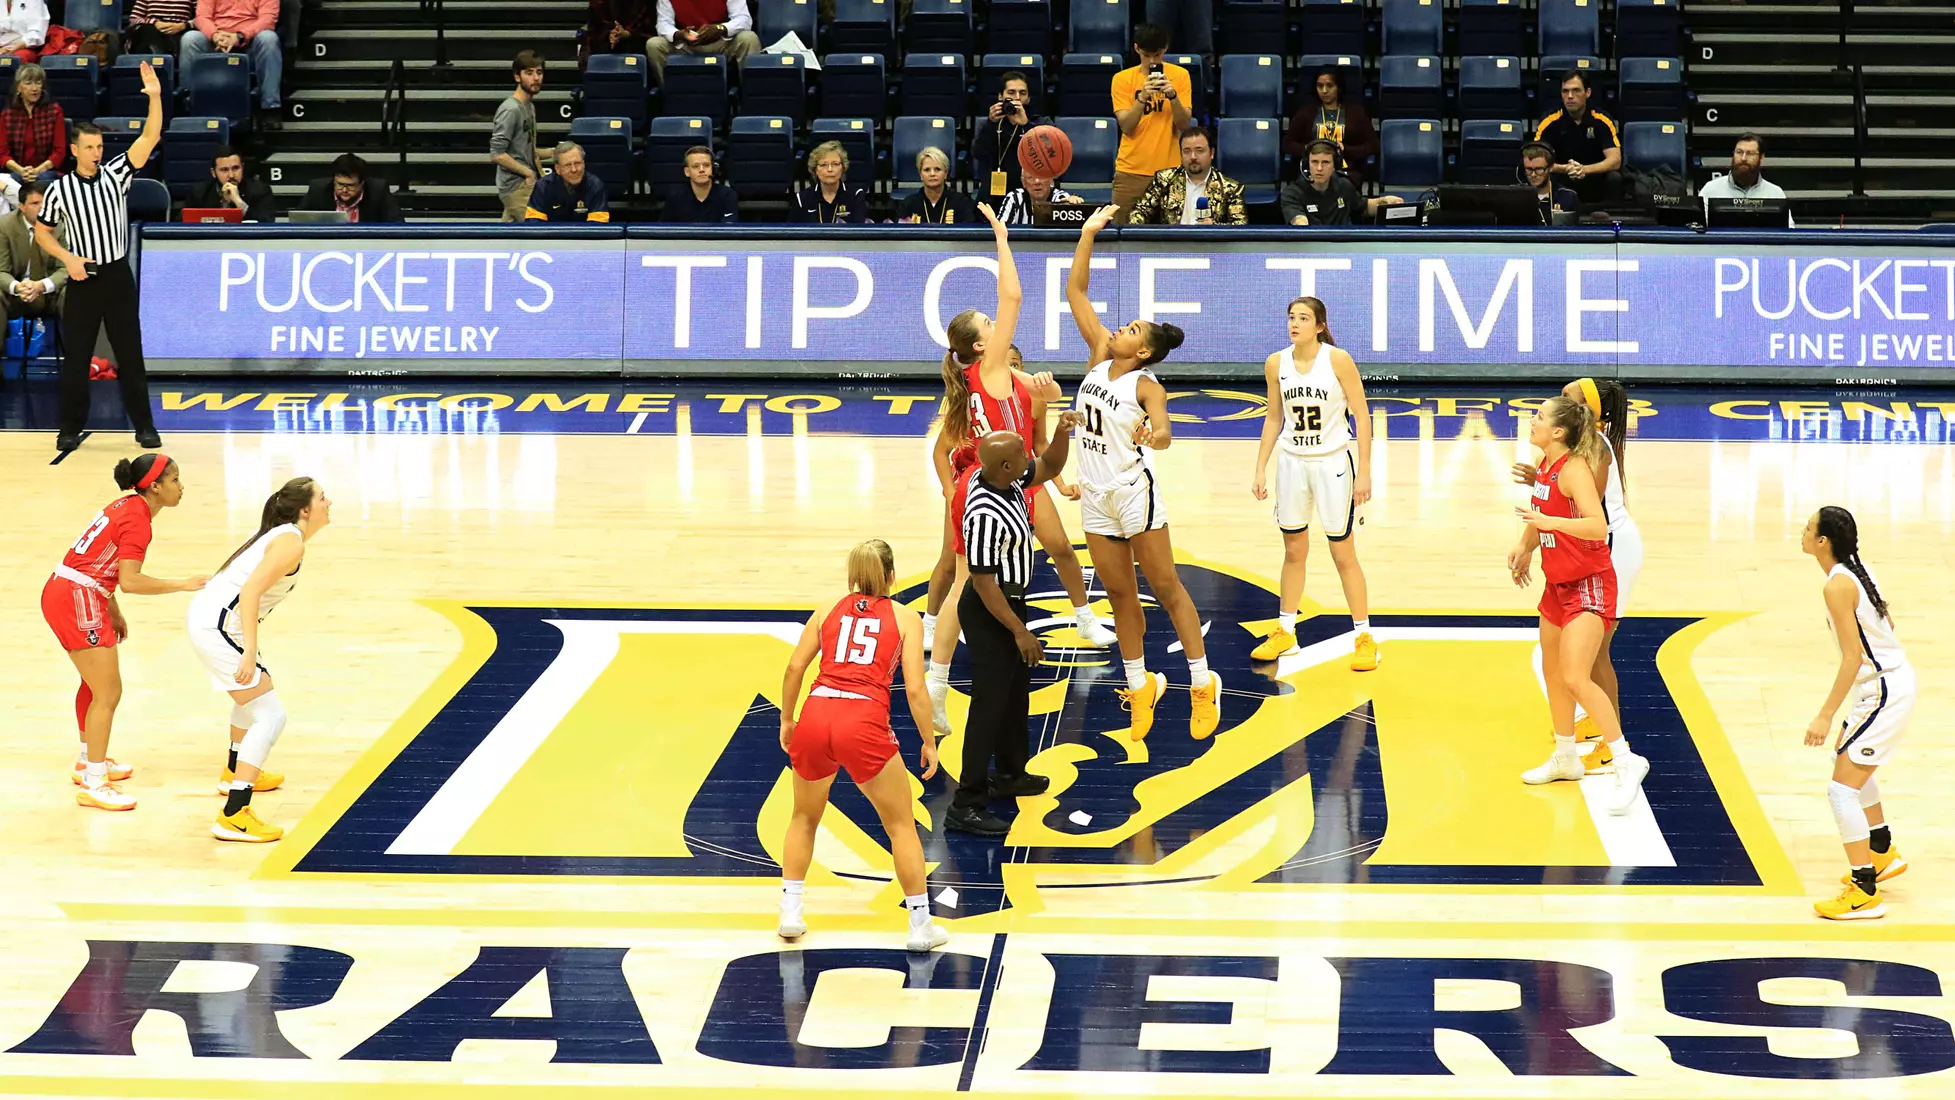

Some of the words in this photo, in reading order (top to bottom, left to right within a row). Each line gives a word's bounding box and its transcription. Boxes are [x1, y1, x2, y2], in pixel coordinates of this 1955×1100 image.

[315, 43, 327, 57] D
[1702, 46, 1714, 60] D
[292, 104, 305, 117] C
[560, 104, 572, 118] C
[1706, 108, 1718, 122] C
[270, 167, 282, 181] B
[1053, 210, 1085, 221] POSS.
[219, 251, 554, 313] PUCKETT'S
[1714, 257, 1955, 321] PUCKET
[641, 255, 874, 349] TIP
[923, 256, 1211, 350] OFF
[1265, 257, 1642, 353] TIME
[271, 326, 345, 352] FINE
[355, 326, 500, 358] JEWELRY
[1769, 333, 1845, 360] FINE
[1857, 334, 1955, 367] JEWEL
[161, 392, 676, 412] WELCOME
[705, 394, 841, 414] TO
[1081, 383, 1120, 412] MURRAY
[1283, 386, 1329, 402] MURRAY
[1084, 403, 1104, 438] 11
[1292, 405, 1322, 431] 32
[1082, 437, 1108, 455] STATE
[1292, 434, 1322, 446] STATE
[834, 614, 881, 665] 15
[3, 939, 1955, 1080] RACERS
